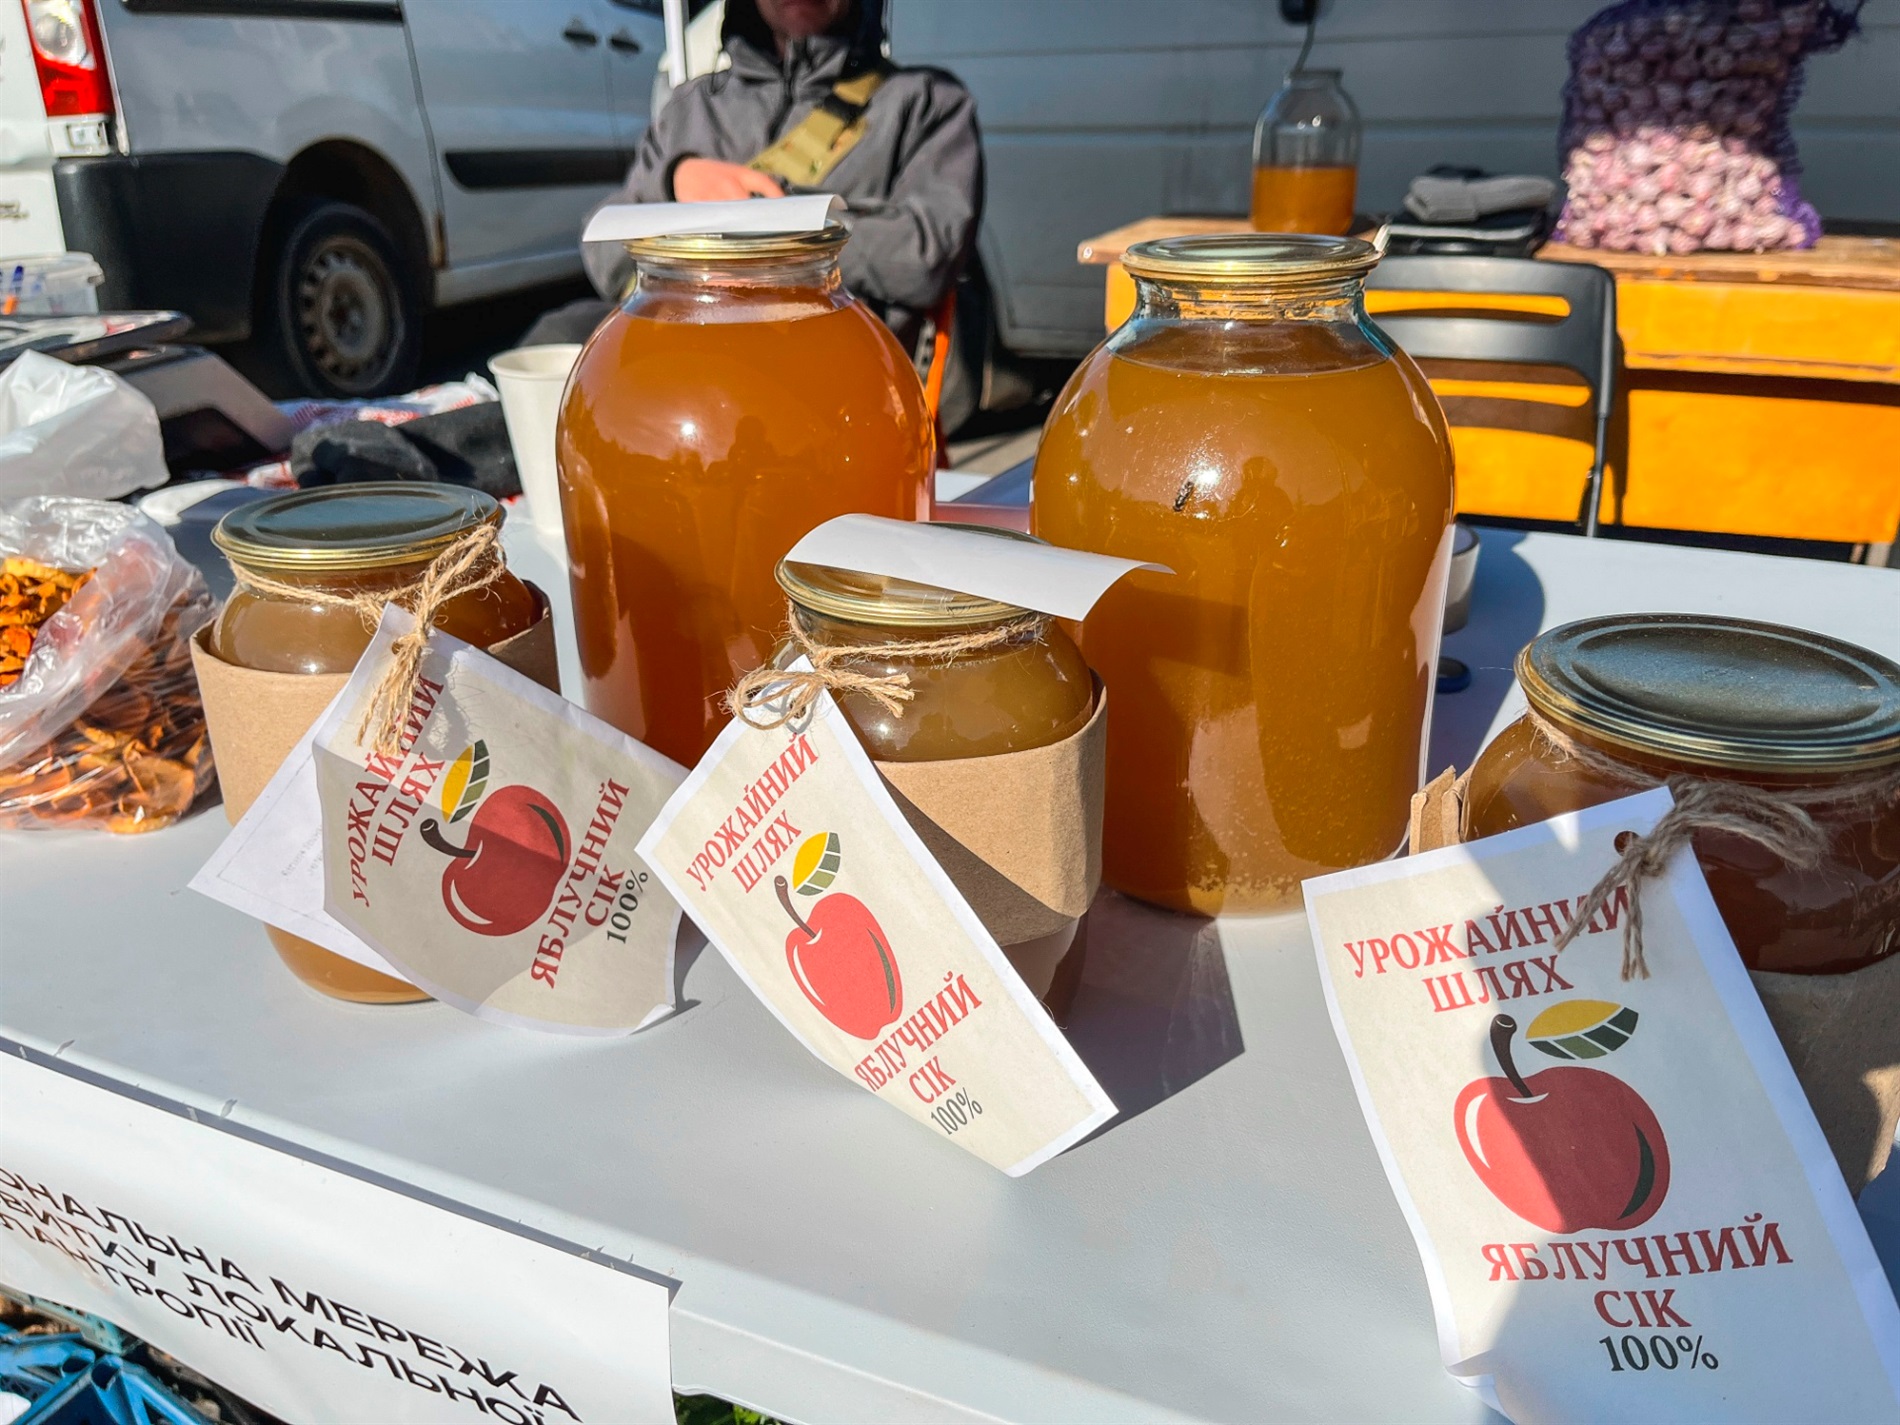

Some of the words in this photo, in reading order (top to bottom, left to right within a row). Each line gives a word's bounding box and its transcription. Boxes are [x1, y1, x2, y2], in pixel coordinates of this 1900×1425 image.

[371, 752, 445, 866] ШЛЯХ
[686, 731, 819, 892] УРОЖАЙНИЙ
[530, 777, 630, 989] ЯБЛУЧНИЙ
[731, 809, 802, 894] ШЛЯХ
[584, 864, 625, 927] СІК
[606, 869, 649, 944] 100%
[1421, 954, 1574, 1013] ШЛЯХ
[854, 970, 983, 1092] ЯБЛУЧНИЙ
[909, 1055, 957, 1104] СІК
[931, 1087, 983, 1135] 100%
[1481, 1212, 1793, 1282] ЯБЛУЧНИЙ
[1593, 1288, 1692, 1328] СІК
[269, 1276, 584, 1424] МЕРЕЖКА
[1599, 1335, 1720, 1373] 100%
